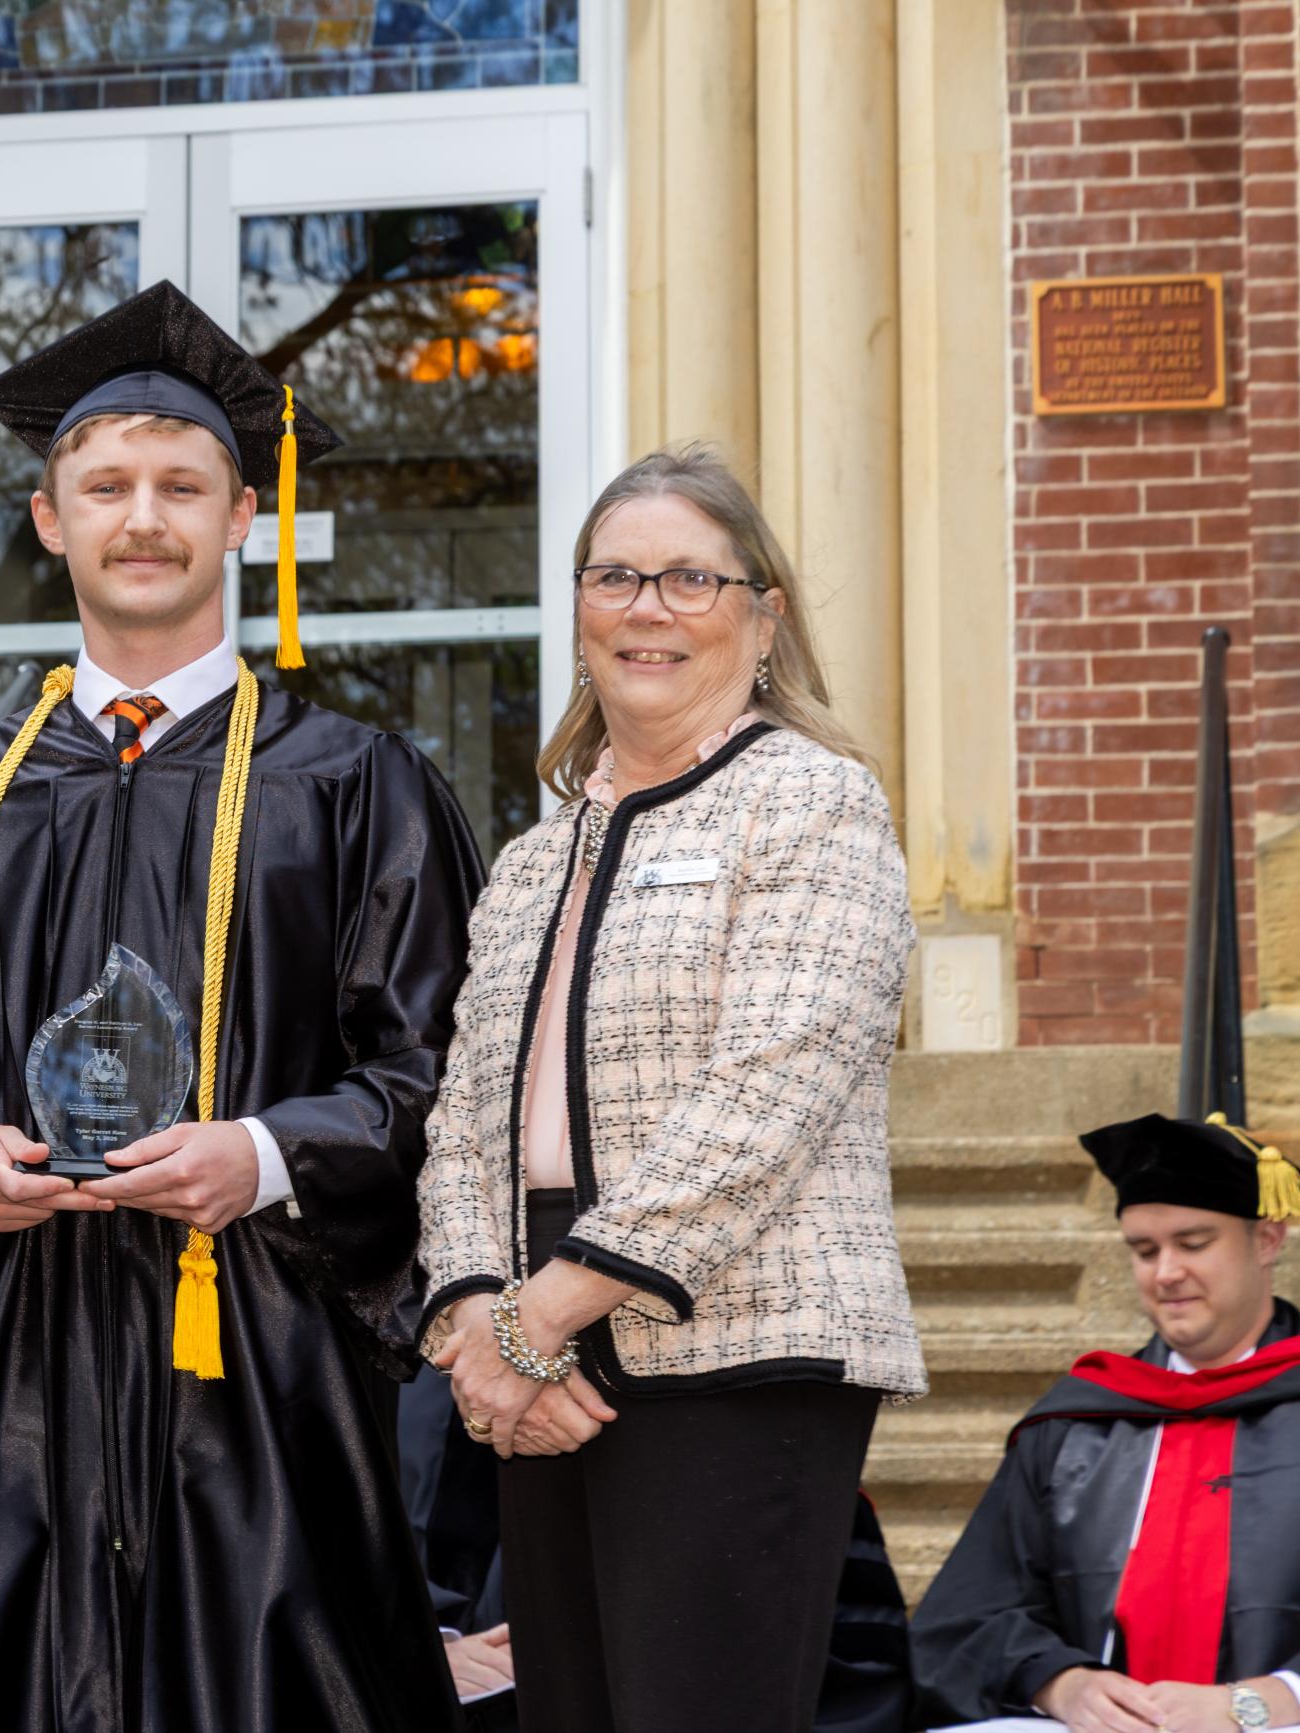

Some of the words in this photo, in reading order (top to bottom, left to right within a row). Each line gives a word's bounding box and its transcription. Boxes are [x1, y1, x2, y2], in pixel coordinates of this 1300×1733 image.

[1090, 287, 1151, 306] MILLER
[1160, 285, 1200, 304] HALL
[1055, 339, 1121, 354] NATIONAL
[1132, 336, 1201, 352] REGISTER
[1151, 354, 1201, 370] PLACES
[79, 1089, 127, 1099] UNIVERSITY
[80, 1082, 128, 1093] WAYNESBURG
[82, 1134, 95, 1142] May
